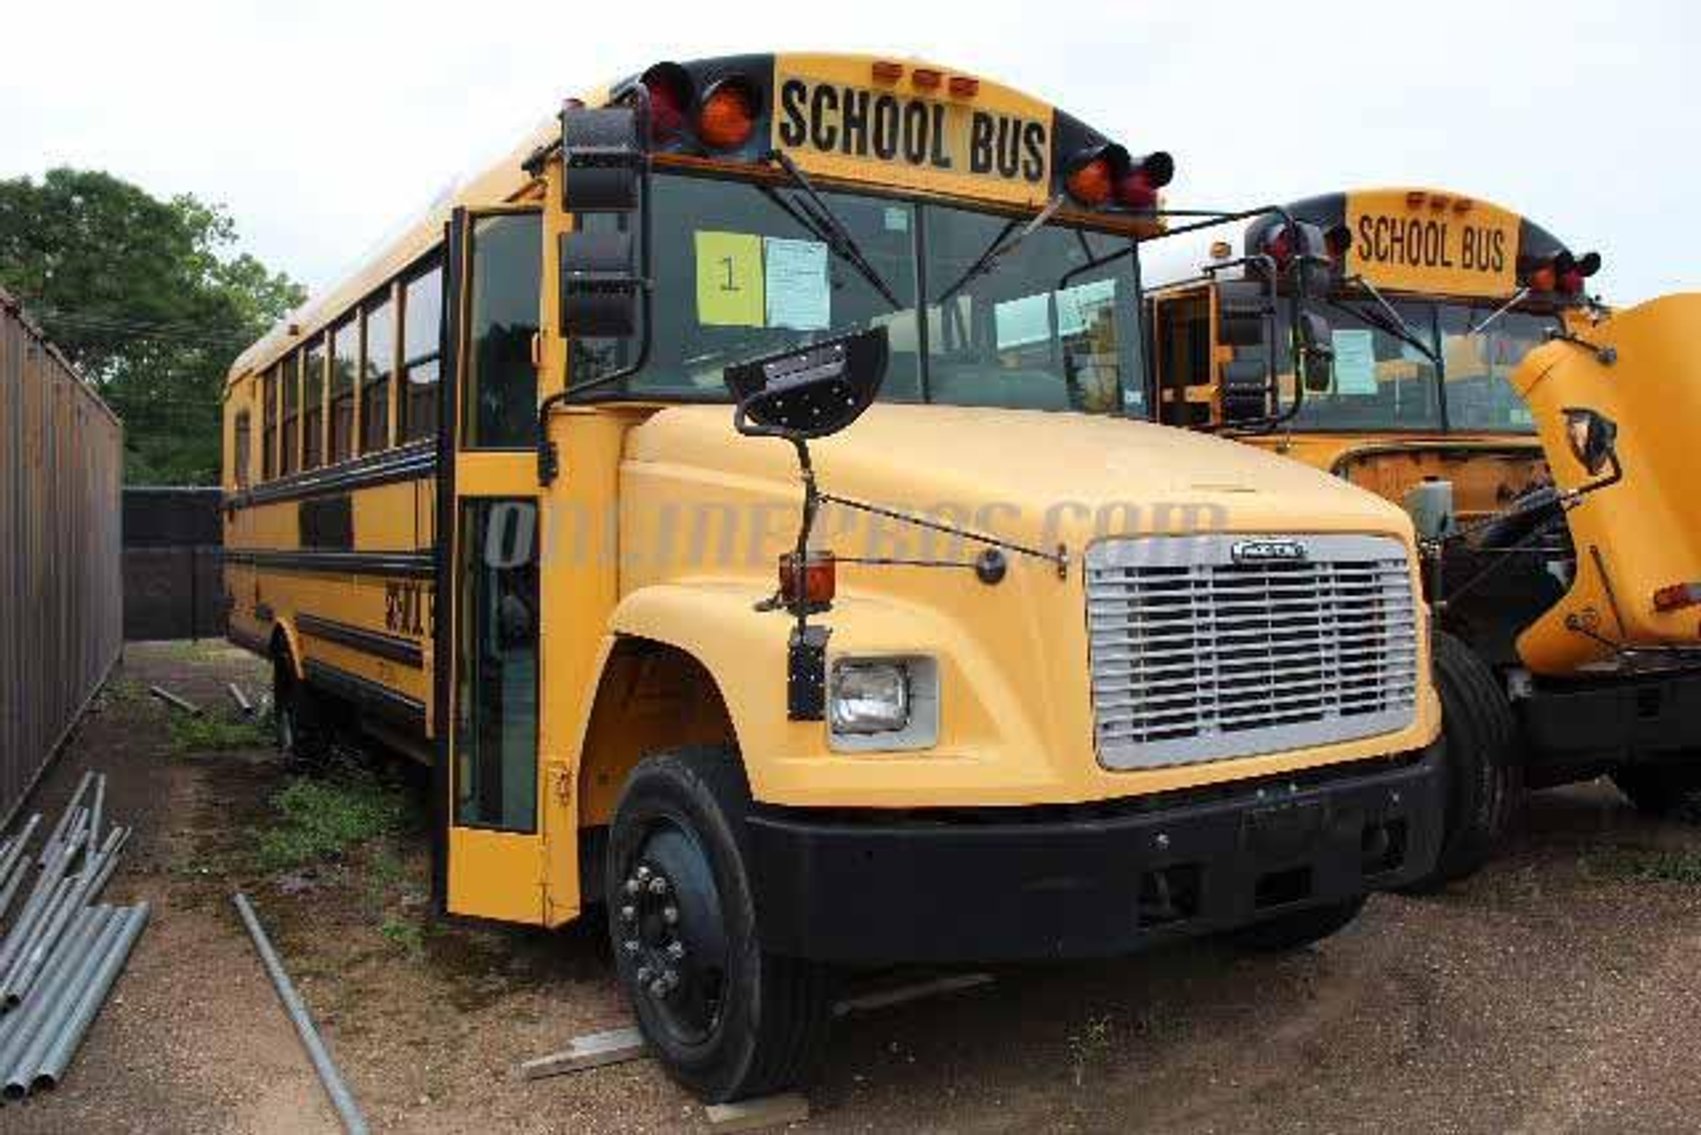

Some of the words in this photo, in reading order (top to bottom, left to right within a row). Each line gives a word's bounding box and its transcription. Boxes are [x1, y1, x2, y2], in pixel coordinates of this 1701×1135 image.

[778, 79, 953, 169] SCHOOL
[970, 111, 1046, 182] BUS
[720, 255, 741, 291] 1
[1358, 214, 1453, 268] SCHOOL
[1461, 225, 1504, 273] BUS
